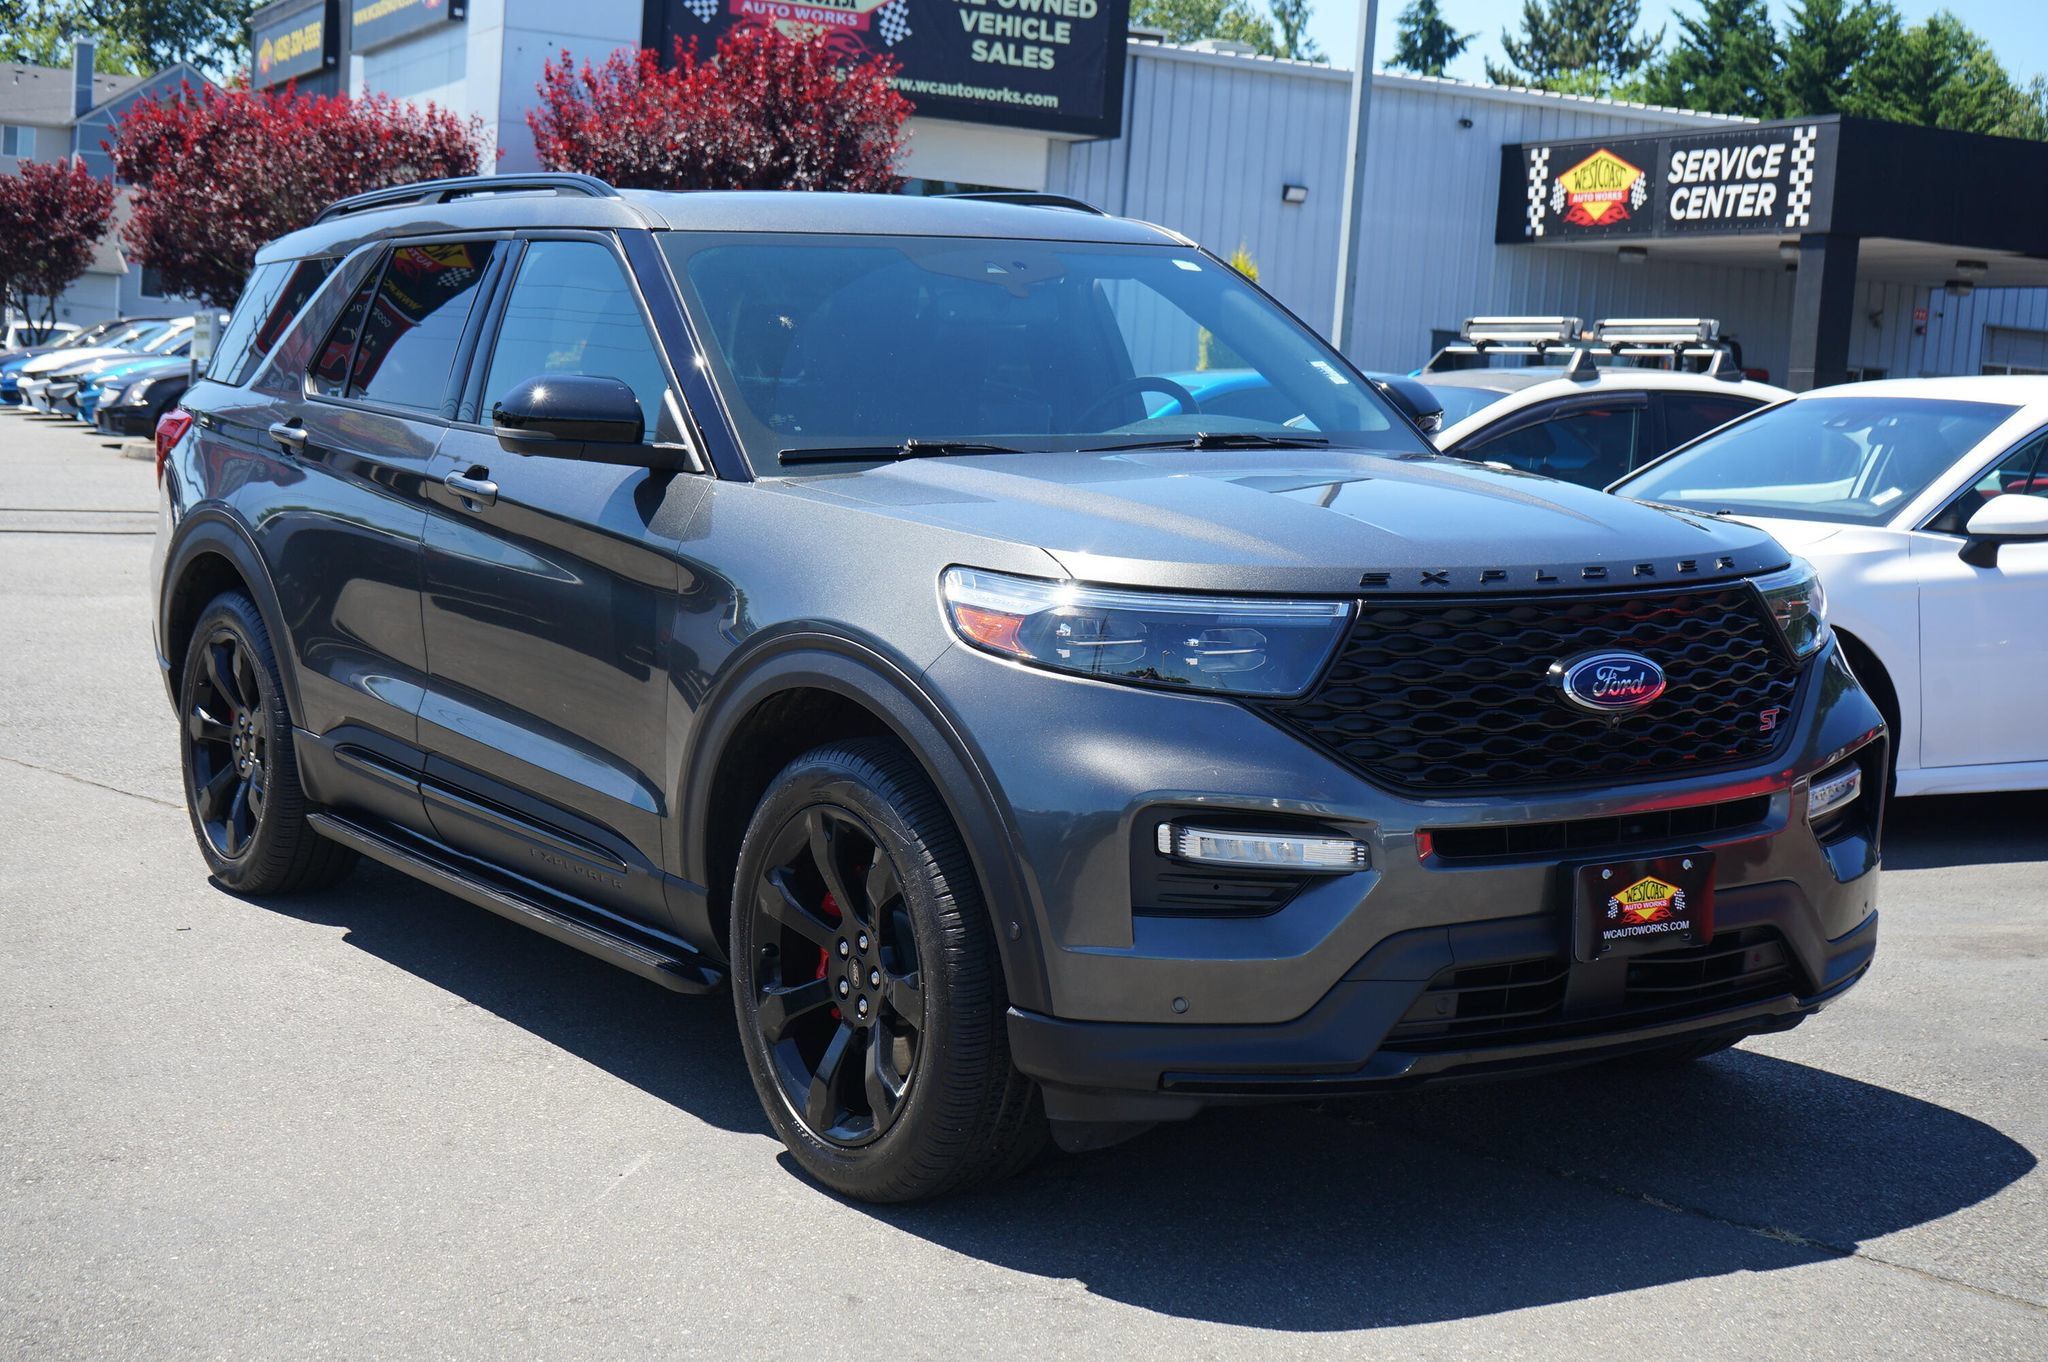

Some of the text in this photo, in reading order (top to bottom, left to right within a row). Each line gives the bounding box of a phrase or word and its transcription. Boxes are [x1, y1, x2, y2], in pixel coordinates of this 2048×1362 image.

[741, 1, 790, 17] AUTO
[794, 6, 858, 26] WORKS
[959, 9, 1071, 44] VEHICLE
[971, 39, 1055, 70] SALES
[884, 76, 1059, 108] ww.wcautoworks.com
[1667, 143, 1786, 184] SERVICE
[1572, 191, 1623, 203] AUTO WORKS
[1670, 182, 1777, 220] CENTER
[1359, 555, 1736, 587] EXPLORER
[1592, 665, 1646, 697] Ford
[1760, 708, 1780, 731] ST
[528, 848, 623, 889] EXPLORER
[1624, 899, 1668, 911] AUTO WORKS
[1603, 920, 1690, 940] WCAUTOWORKS.COM
